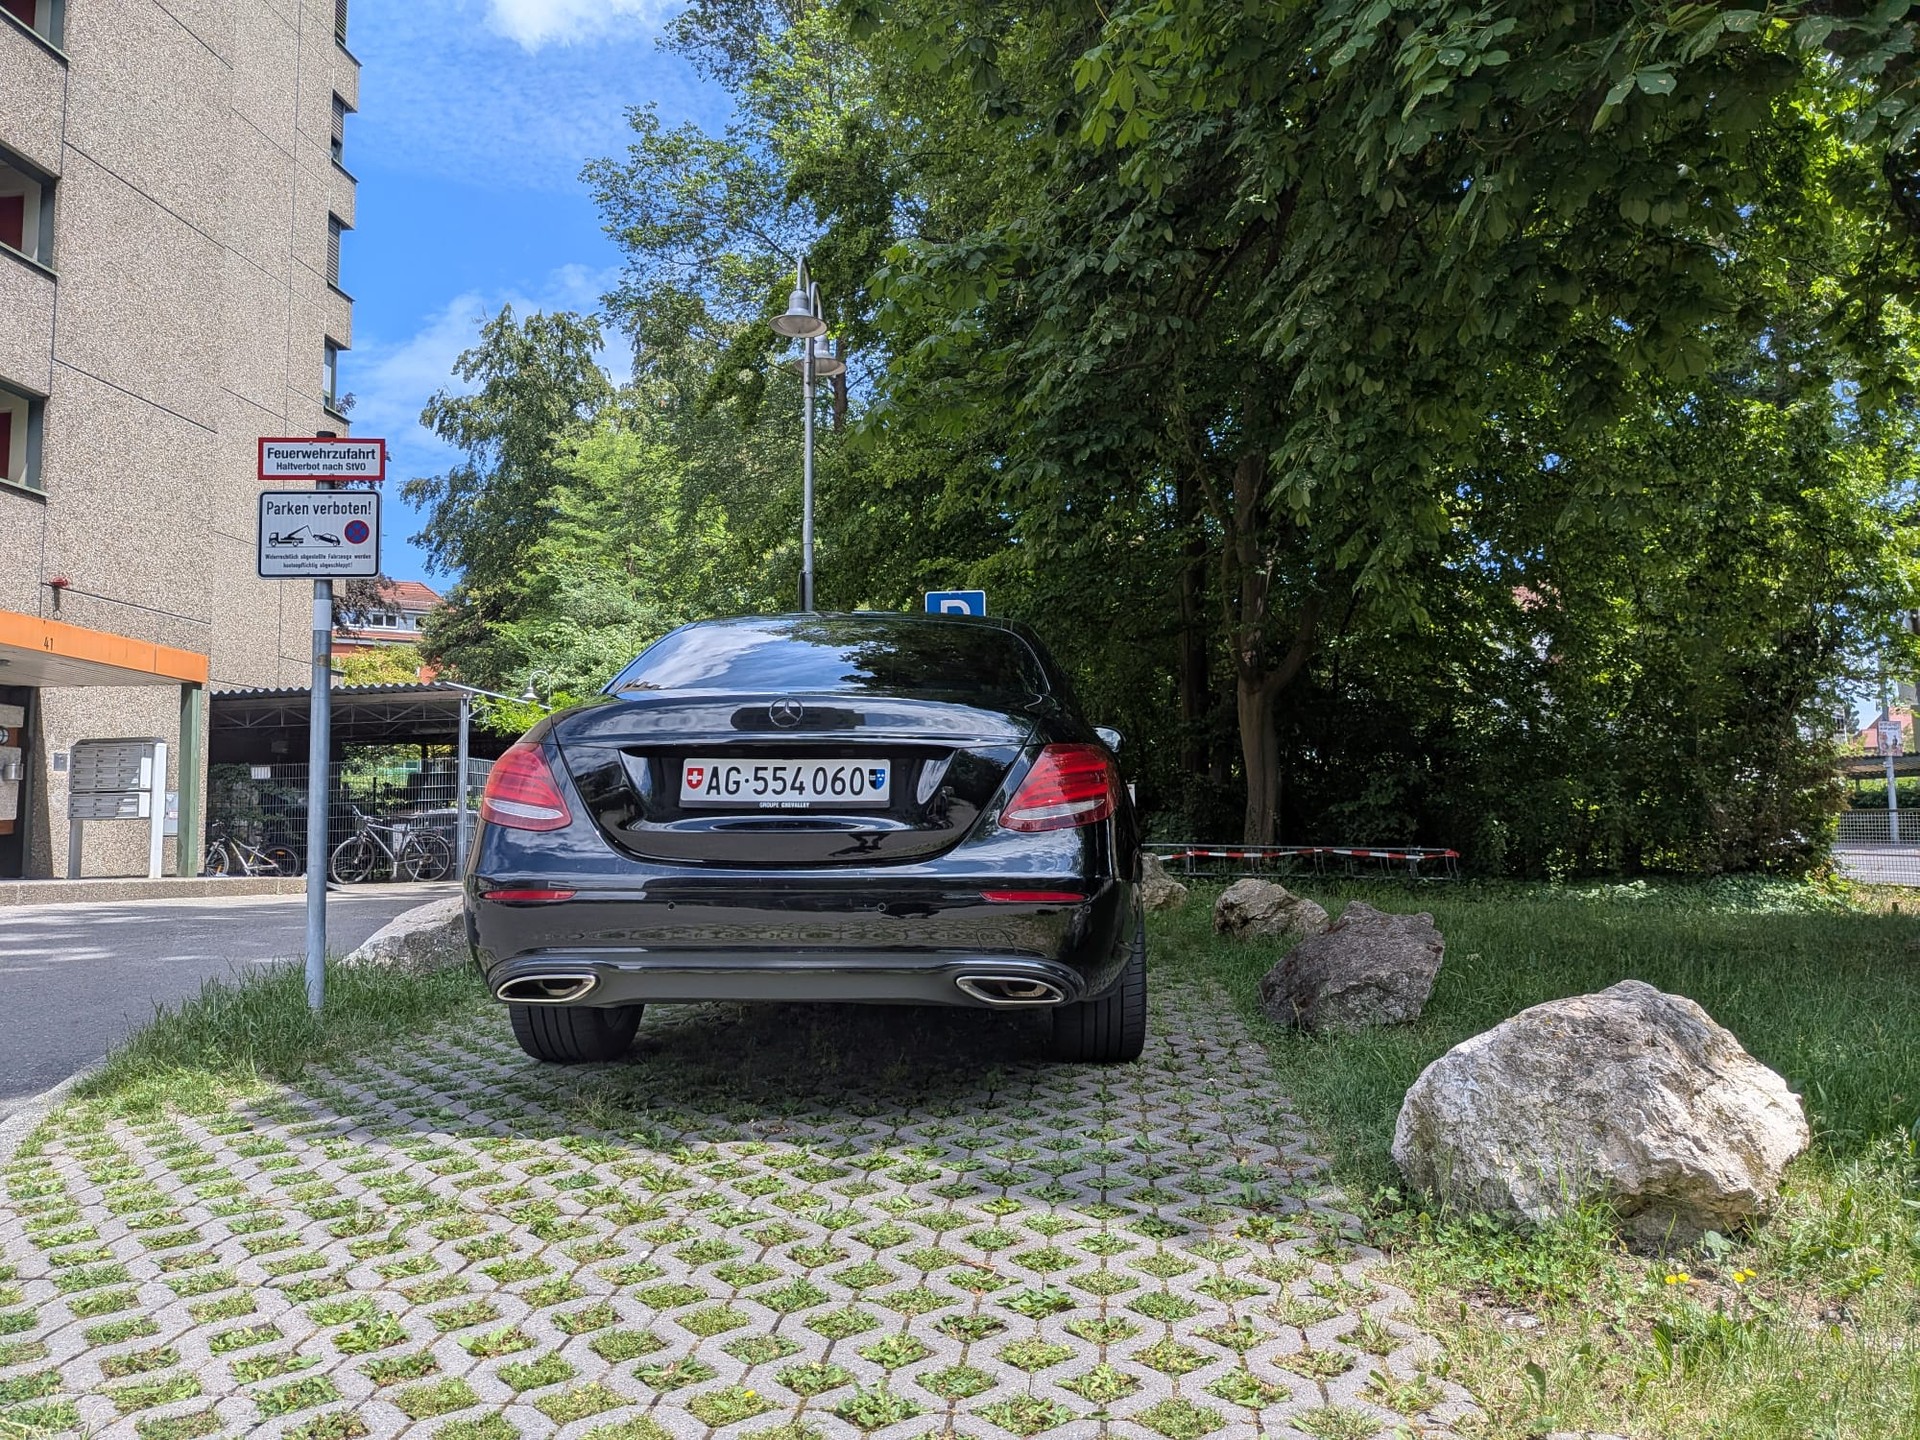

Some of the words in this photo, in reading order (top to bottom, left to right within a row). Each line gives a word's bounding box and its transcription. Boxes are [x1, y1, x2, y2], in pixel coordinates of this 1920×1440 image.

[267, 447, 376, 460] Feuerwehrzufahrt
[276, 462, 320, 471] Haltverbot
[322, 462, 343, 471] nach
[345, 462, 366, 471] StVO
[266, 501, 309, 515] Parken
[313, 501, 371, 515] verboten!
[328, 553, 352, 561] Fahrzeuge
[43, 636, 54, 652] 41
